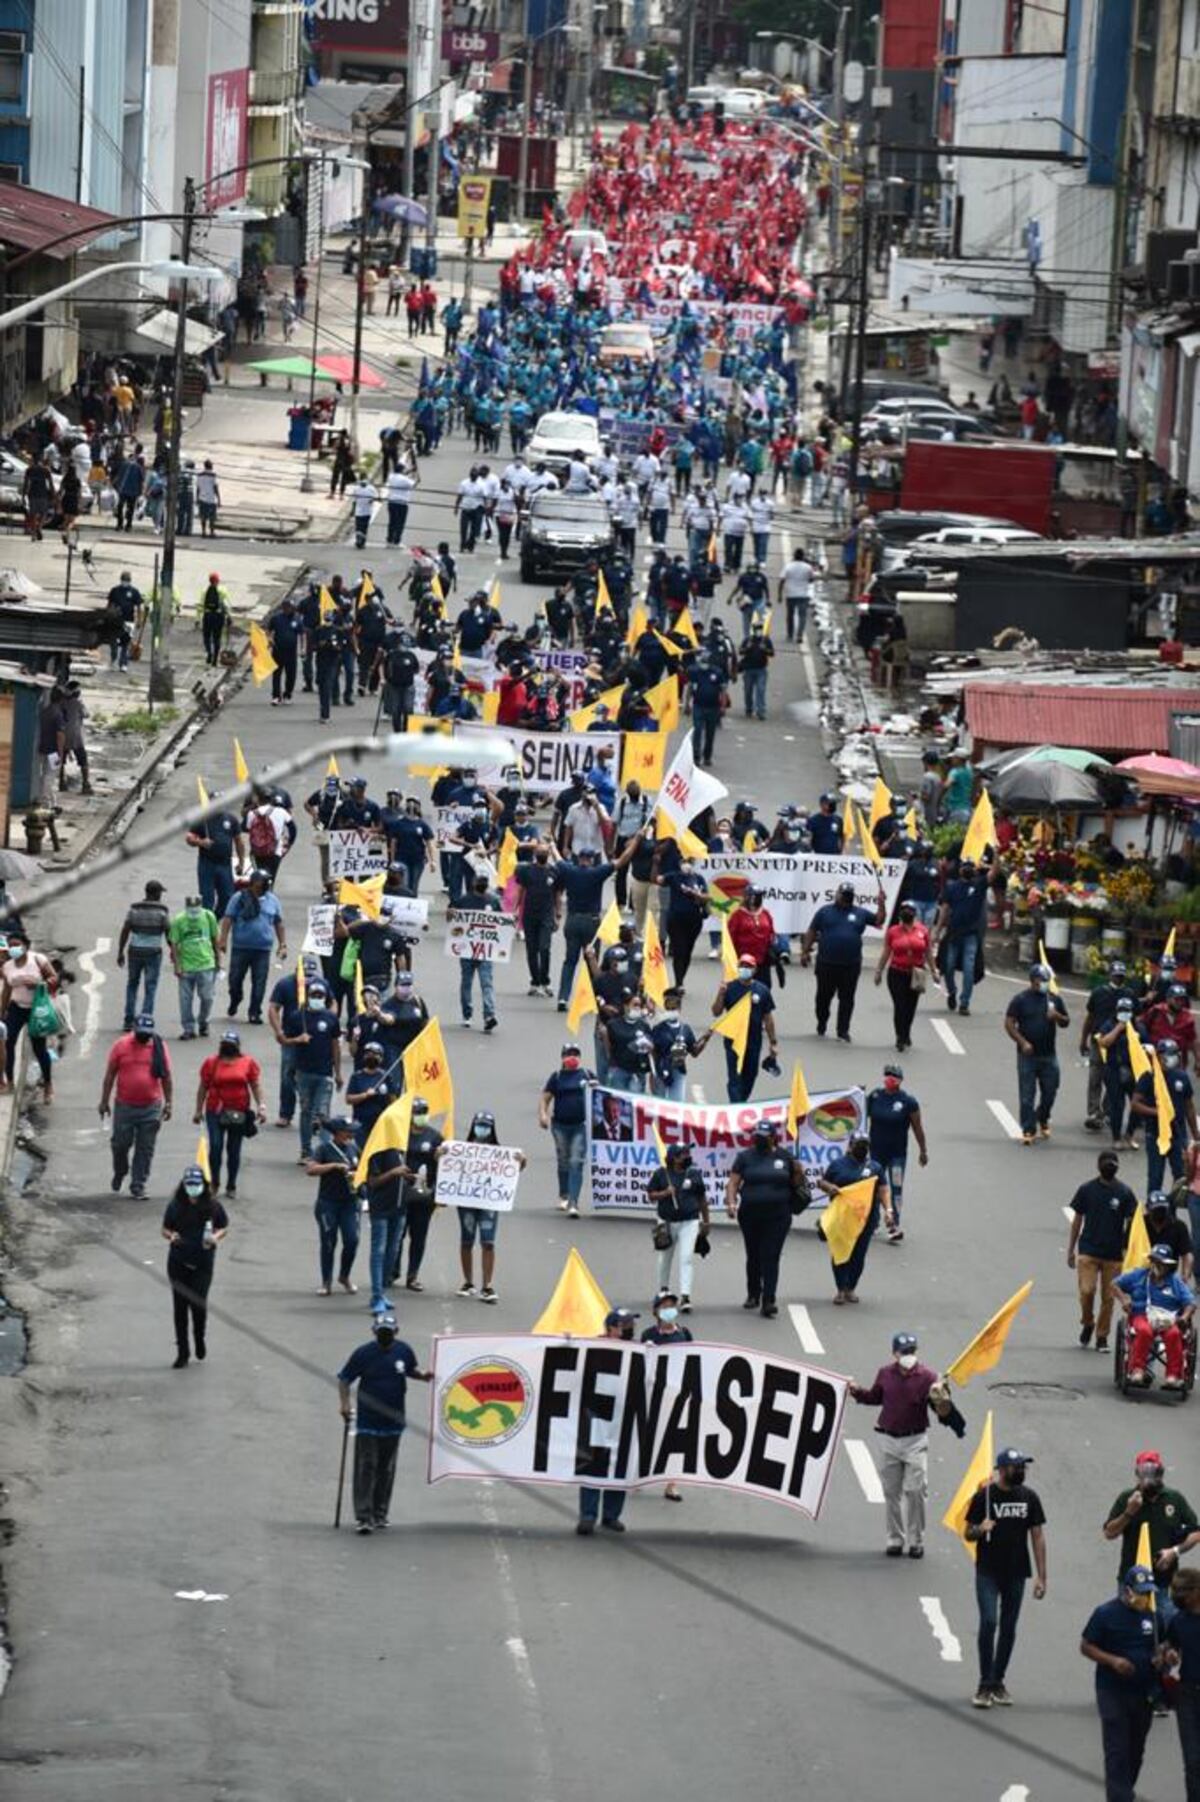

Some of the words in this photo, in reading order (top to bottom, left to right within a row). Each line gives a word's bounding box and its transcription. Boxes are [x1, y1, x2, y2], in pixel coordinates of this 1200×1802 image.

[309, 0, 379, 23] KING
[700, 857, 798, 872] JUVENTUD
[450, 1143, 511, 1161] SISTEMA
[605, 1145, 660, 1165] VIVA
[441, 1158, 517, 1178] SOLIDARIO
[591, 1165, 611, 1177] Por
[615, 1167, 627, 1177] el
[437, 1180, 514, 1202] SOLUCIÓN
[592, 1178, 612, 1190] Por
[615, 1180, 627, 1190] el
[593, 1191, 612, 1202] Por
[615, 1193, 638, 1203] una
[532, 1346, 836, 1499] FENASEP
[992, 1501, 1029, 1519] VANS
